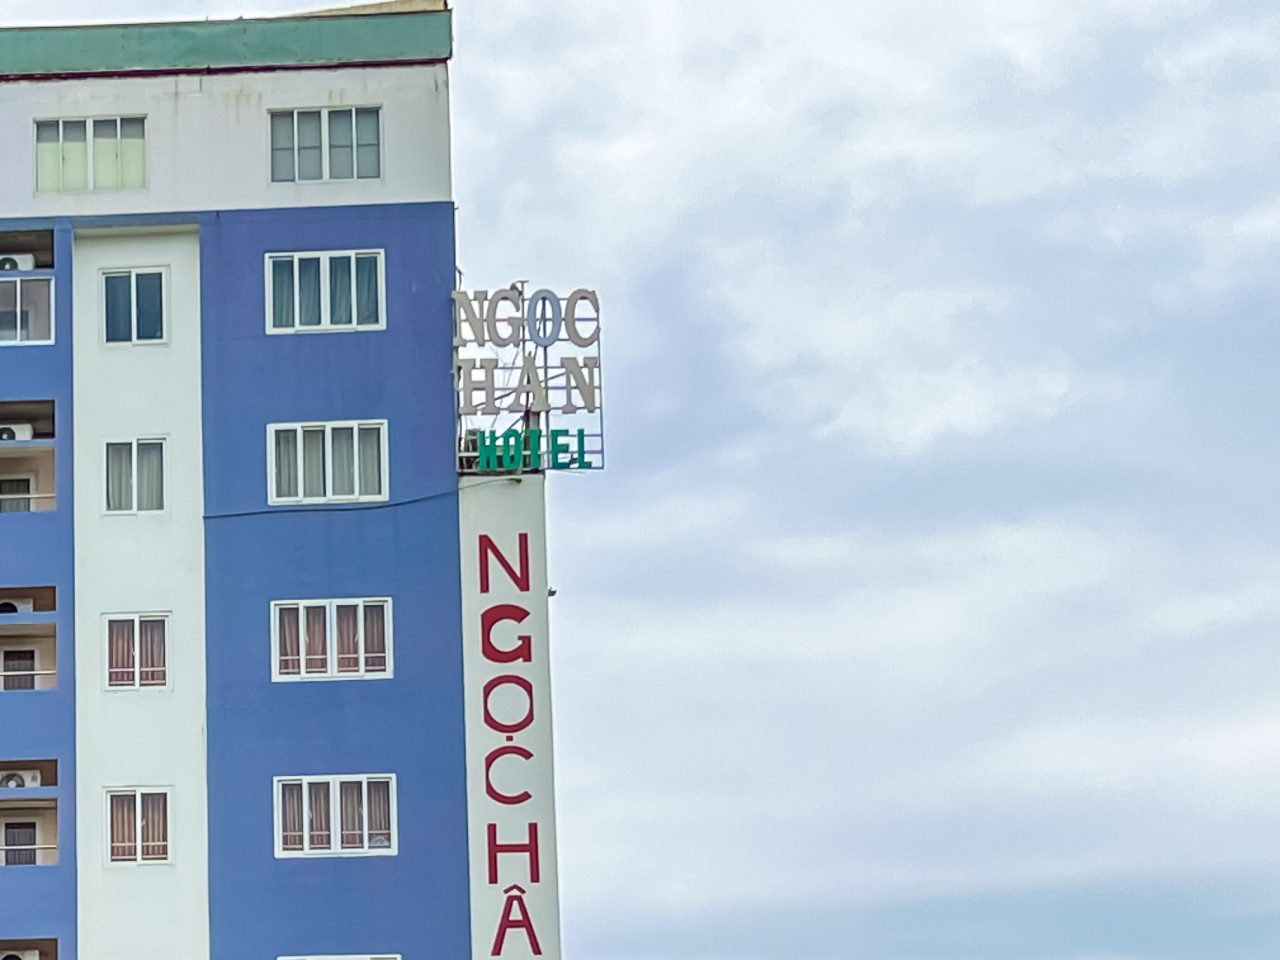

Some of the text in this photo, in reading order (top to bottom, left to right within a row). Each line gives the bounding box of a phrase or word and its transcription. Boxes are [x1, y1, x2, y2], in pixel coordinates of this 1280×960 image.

[452, 289, 600, 347] NGOC
[458, 354, 598, 414] HAN
[479, 429, 592, 470] HOTEL
[478, 532, 534, 805] NGỌC
